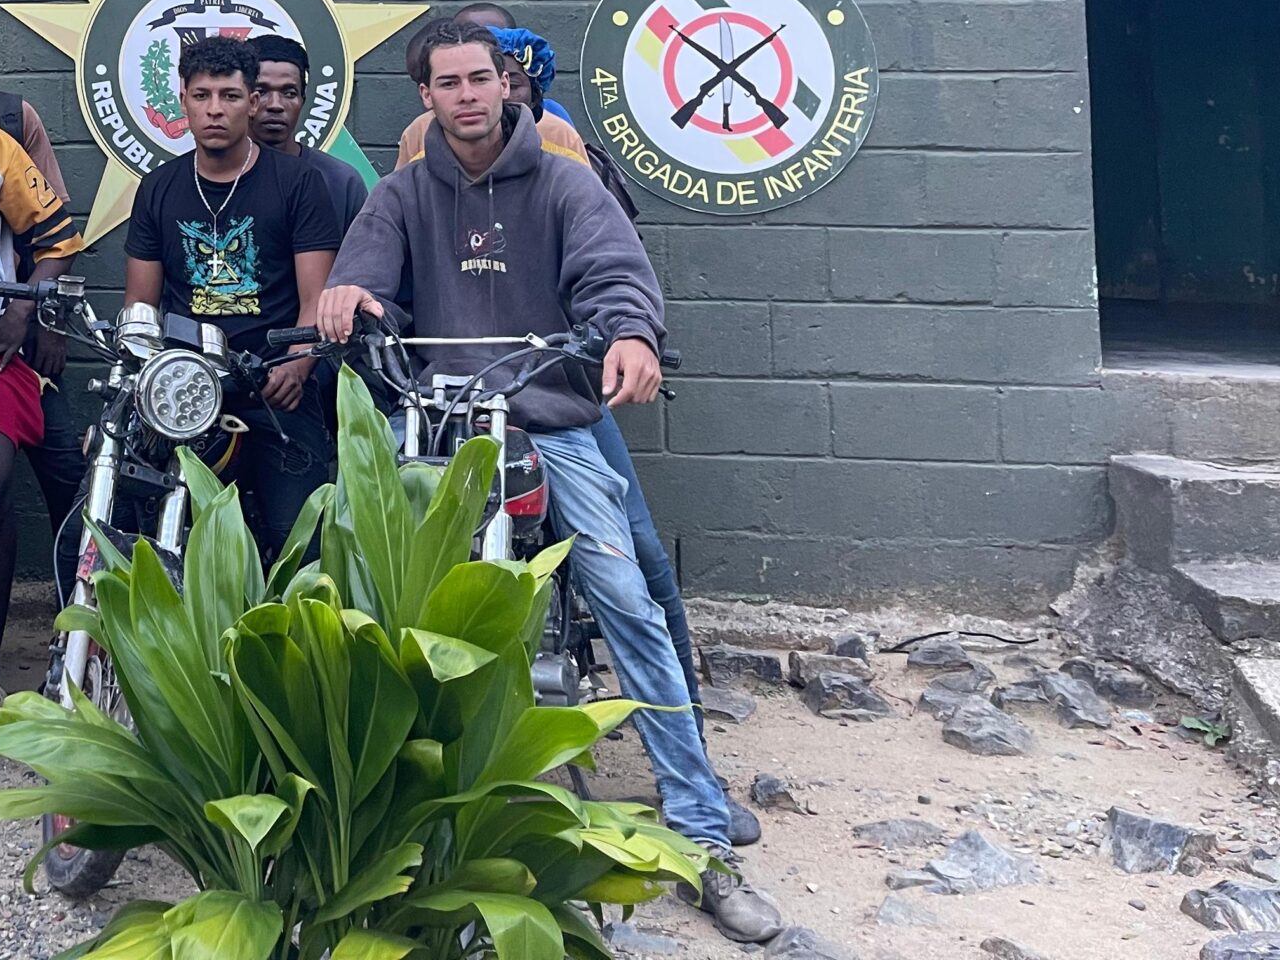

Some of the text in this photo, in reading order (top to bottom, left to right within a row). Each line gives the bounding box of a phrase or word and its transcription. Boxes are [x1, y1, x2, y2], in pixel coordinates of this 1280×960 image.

[173, 6, 188, 15] DIOS
[92, 81, 166, 174] REPUBL
[603, 113, 709, 203] BRIGADA
[717, 180, 758, 205] DE
[764, 66, 870, 200] INFANTERIA
